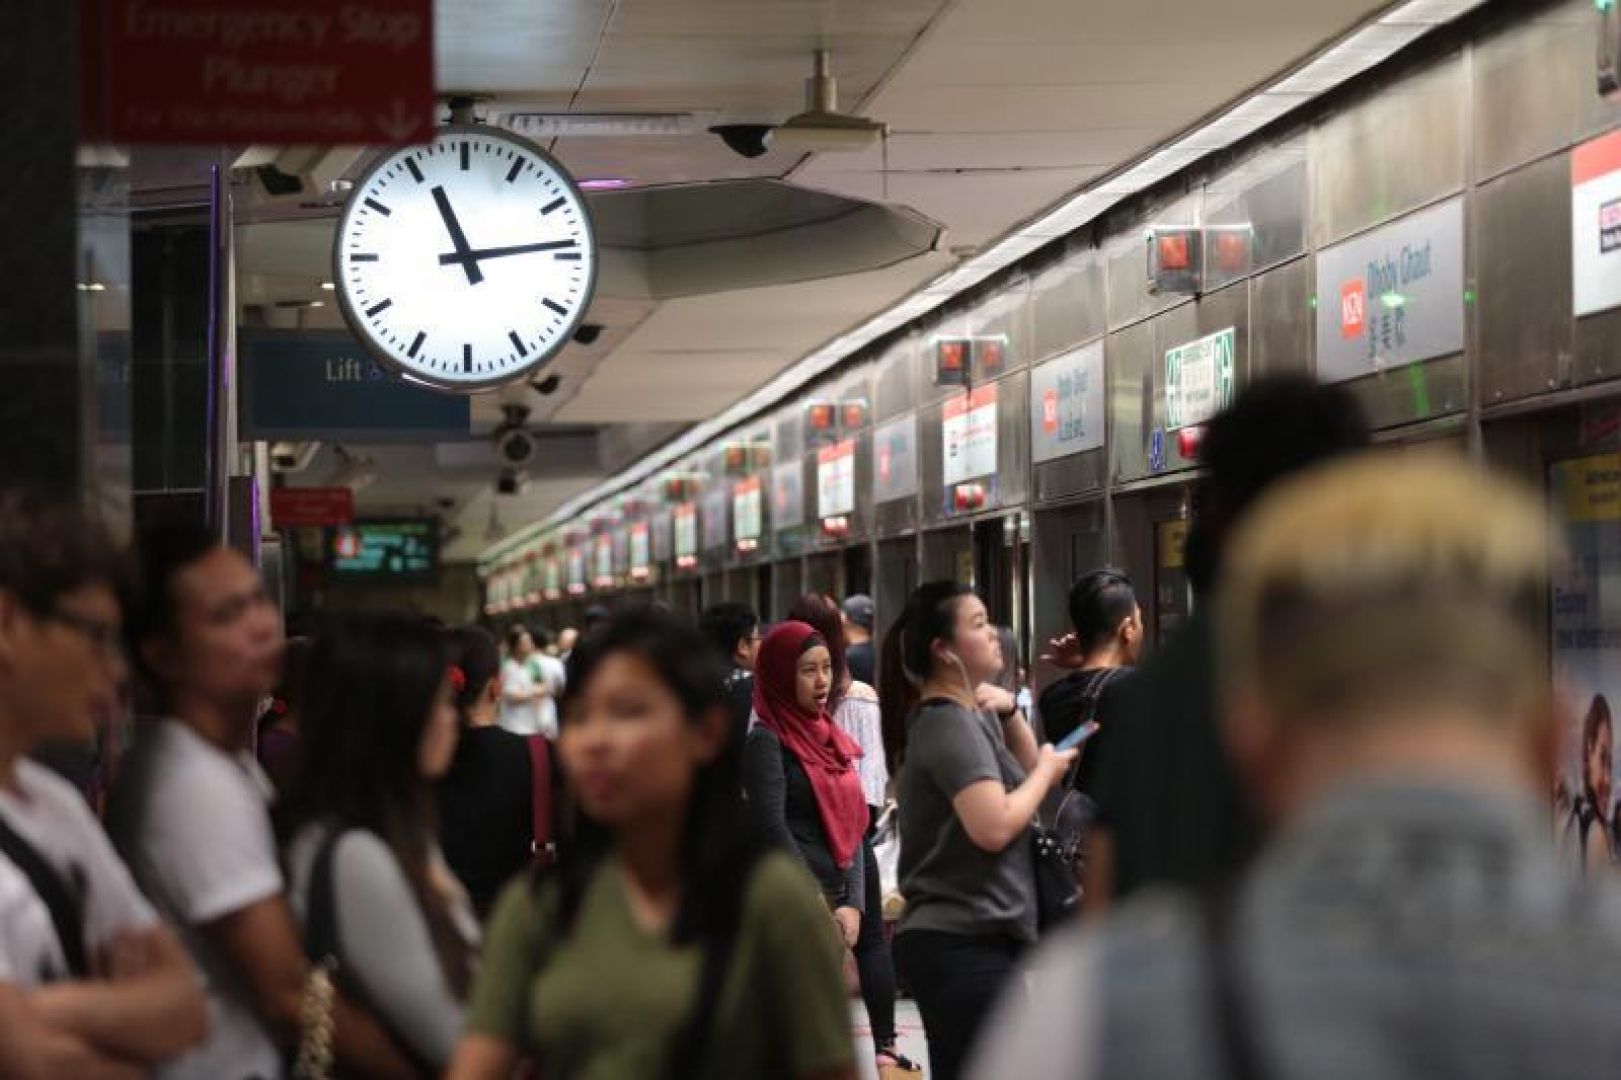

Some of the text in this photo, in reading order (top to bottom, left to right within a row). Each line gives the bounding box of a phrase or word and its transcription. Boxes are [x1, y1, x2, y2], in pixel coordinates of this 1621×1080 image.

[124, 3, 420, 48] Emergency Stop
[203, 55, 341, 100] Plunger
[325, 357, 361, 381] Lift
